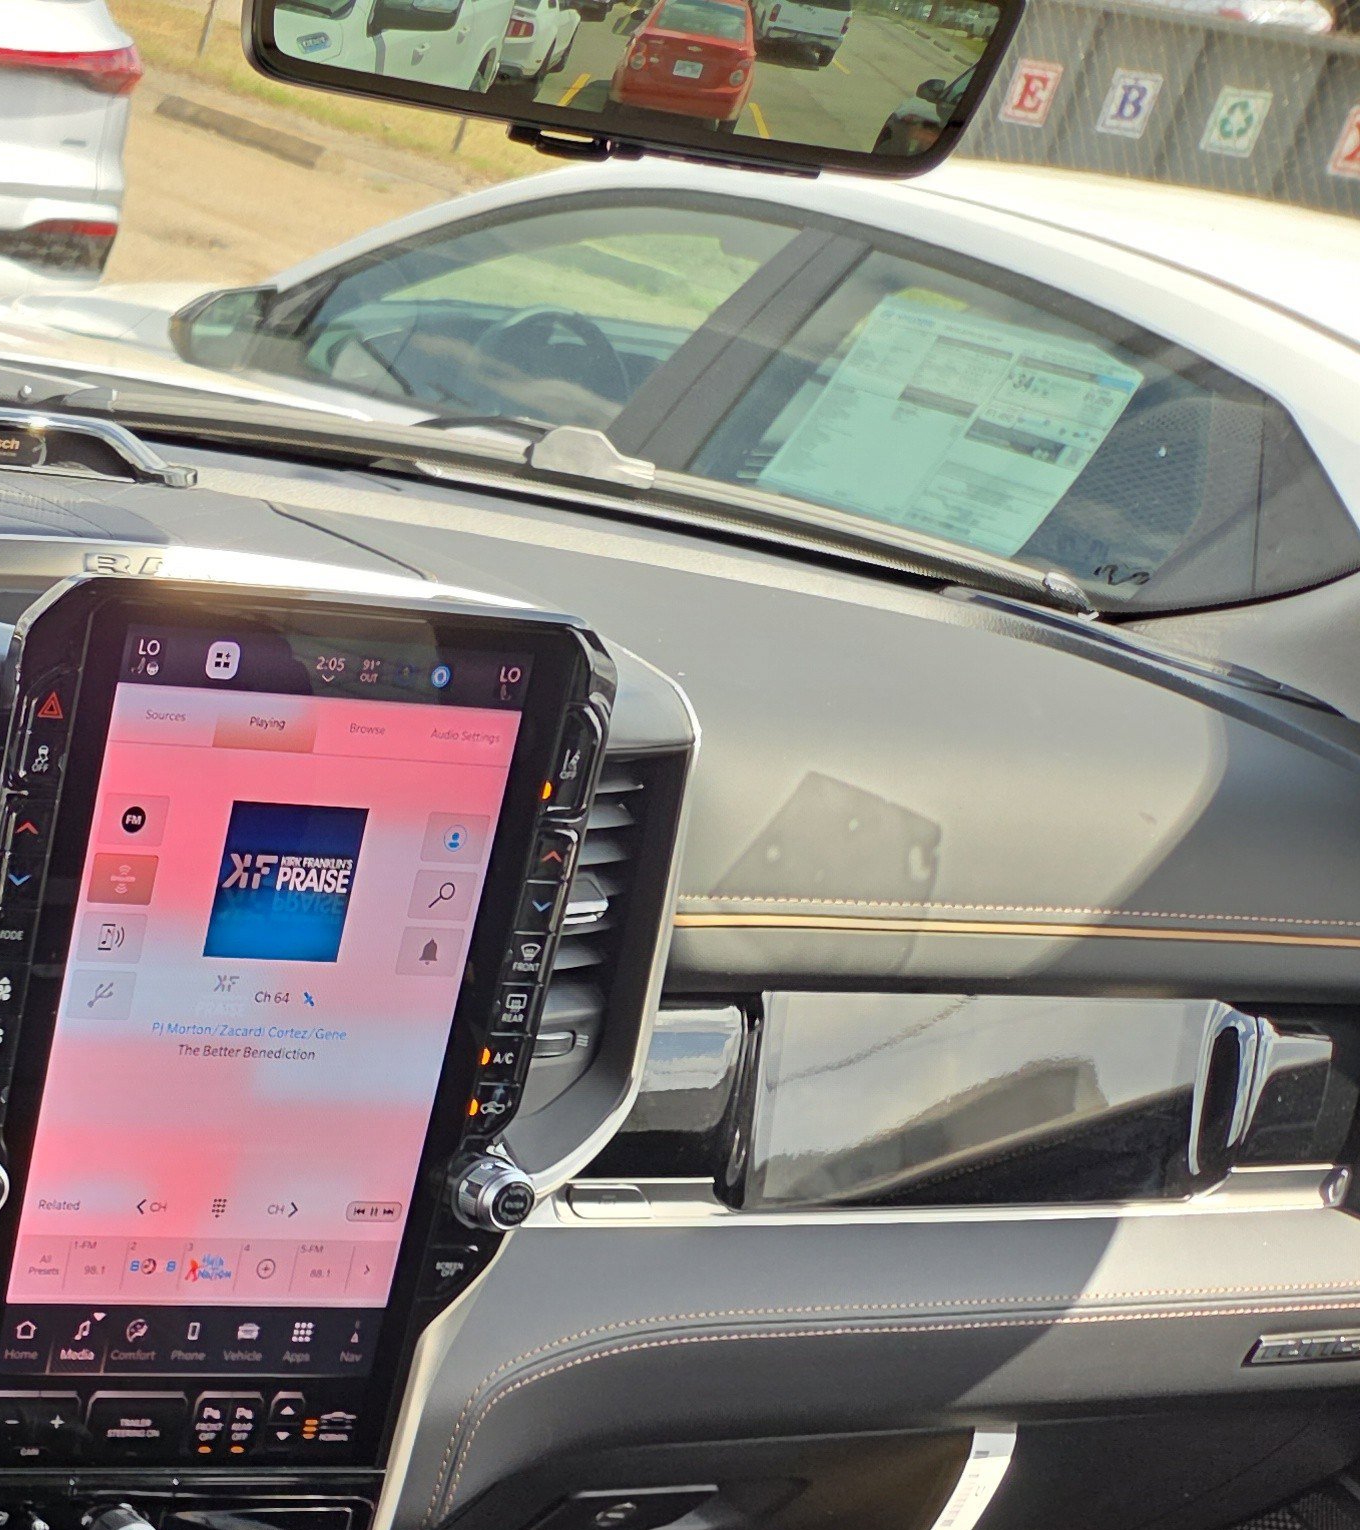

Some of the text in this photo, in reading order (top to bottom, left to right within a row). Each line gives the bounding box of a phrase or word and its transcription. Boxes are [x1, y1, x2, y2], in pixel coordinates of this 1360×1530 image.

[1113, 85, 1148, 121] B
[138, 639, 161, 656] LO
[316, 657, 346, 671] 2:05
[500, 666, 521, 682] LO
[145, 709, 186, 722] Sources
[249, 715, 286, 731] Playing
[349, 722, 386, 736] Browse
[430, 728, 459, 741] Audio
[125, 814, 142, 826] FM
[281, 855, 302, 868] KIRK
[275, 867, 351, 893] PRAISE
[255, 991, 290, 1005] Ch 64
[178, 1044, 316, 1061] The Better Benediction
[493, 1051, 514, 1065] A/C
[38, 1200, 80, 1212] Related
[4, 1349, 38, 1361] Home
[60, 1348, 94, 1361] Media
[111, 1348, 157, 1361] Comfort
[171, 1350, 206, 1362] Phone
[223, 1349, 263, 1362] Vehicle
[282, 1350, 310, 1364] Apps
[340, 1351, 362, 1363] Nav
